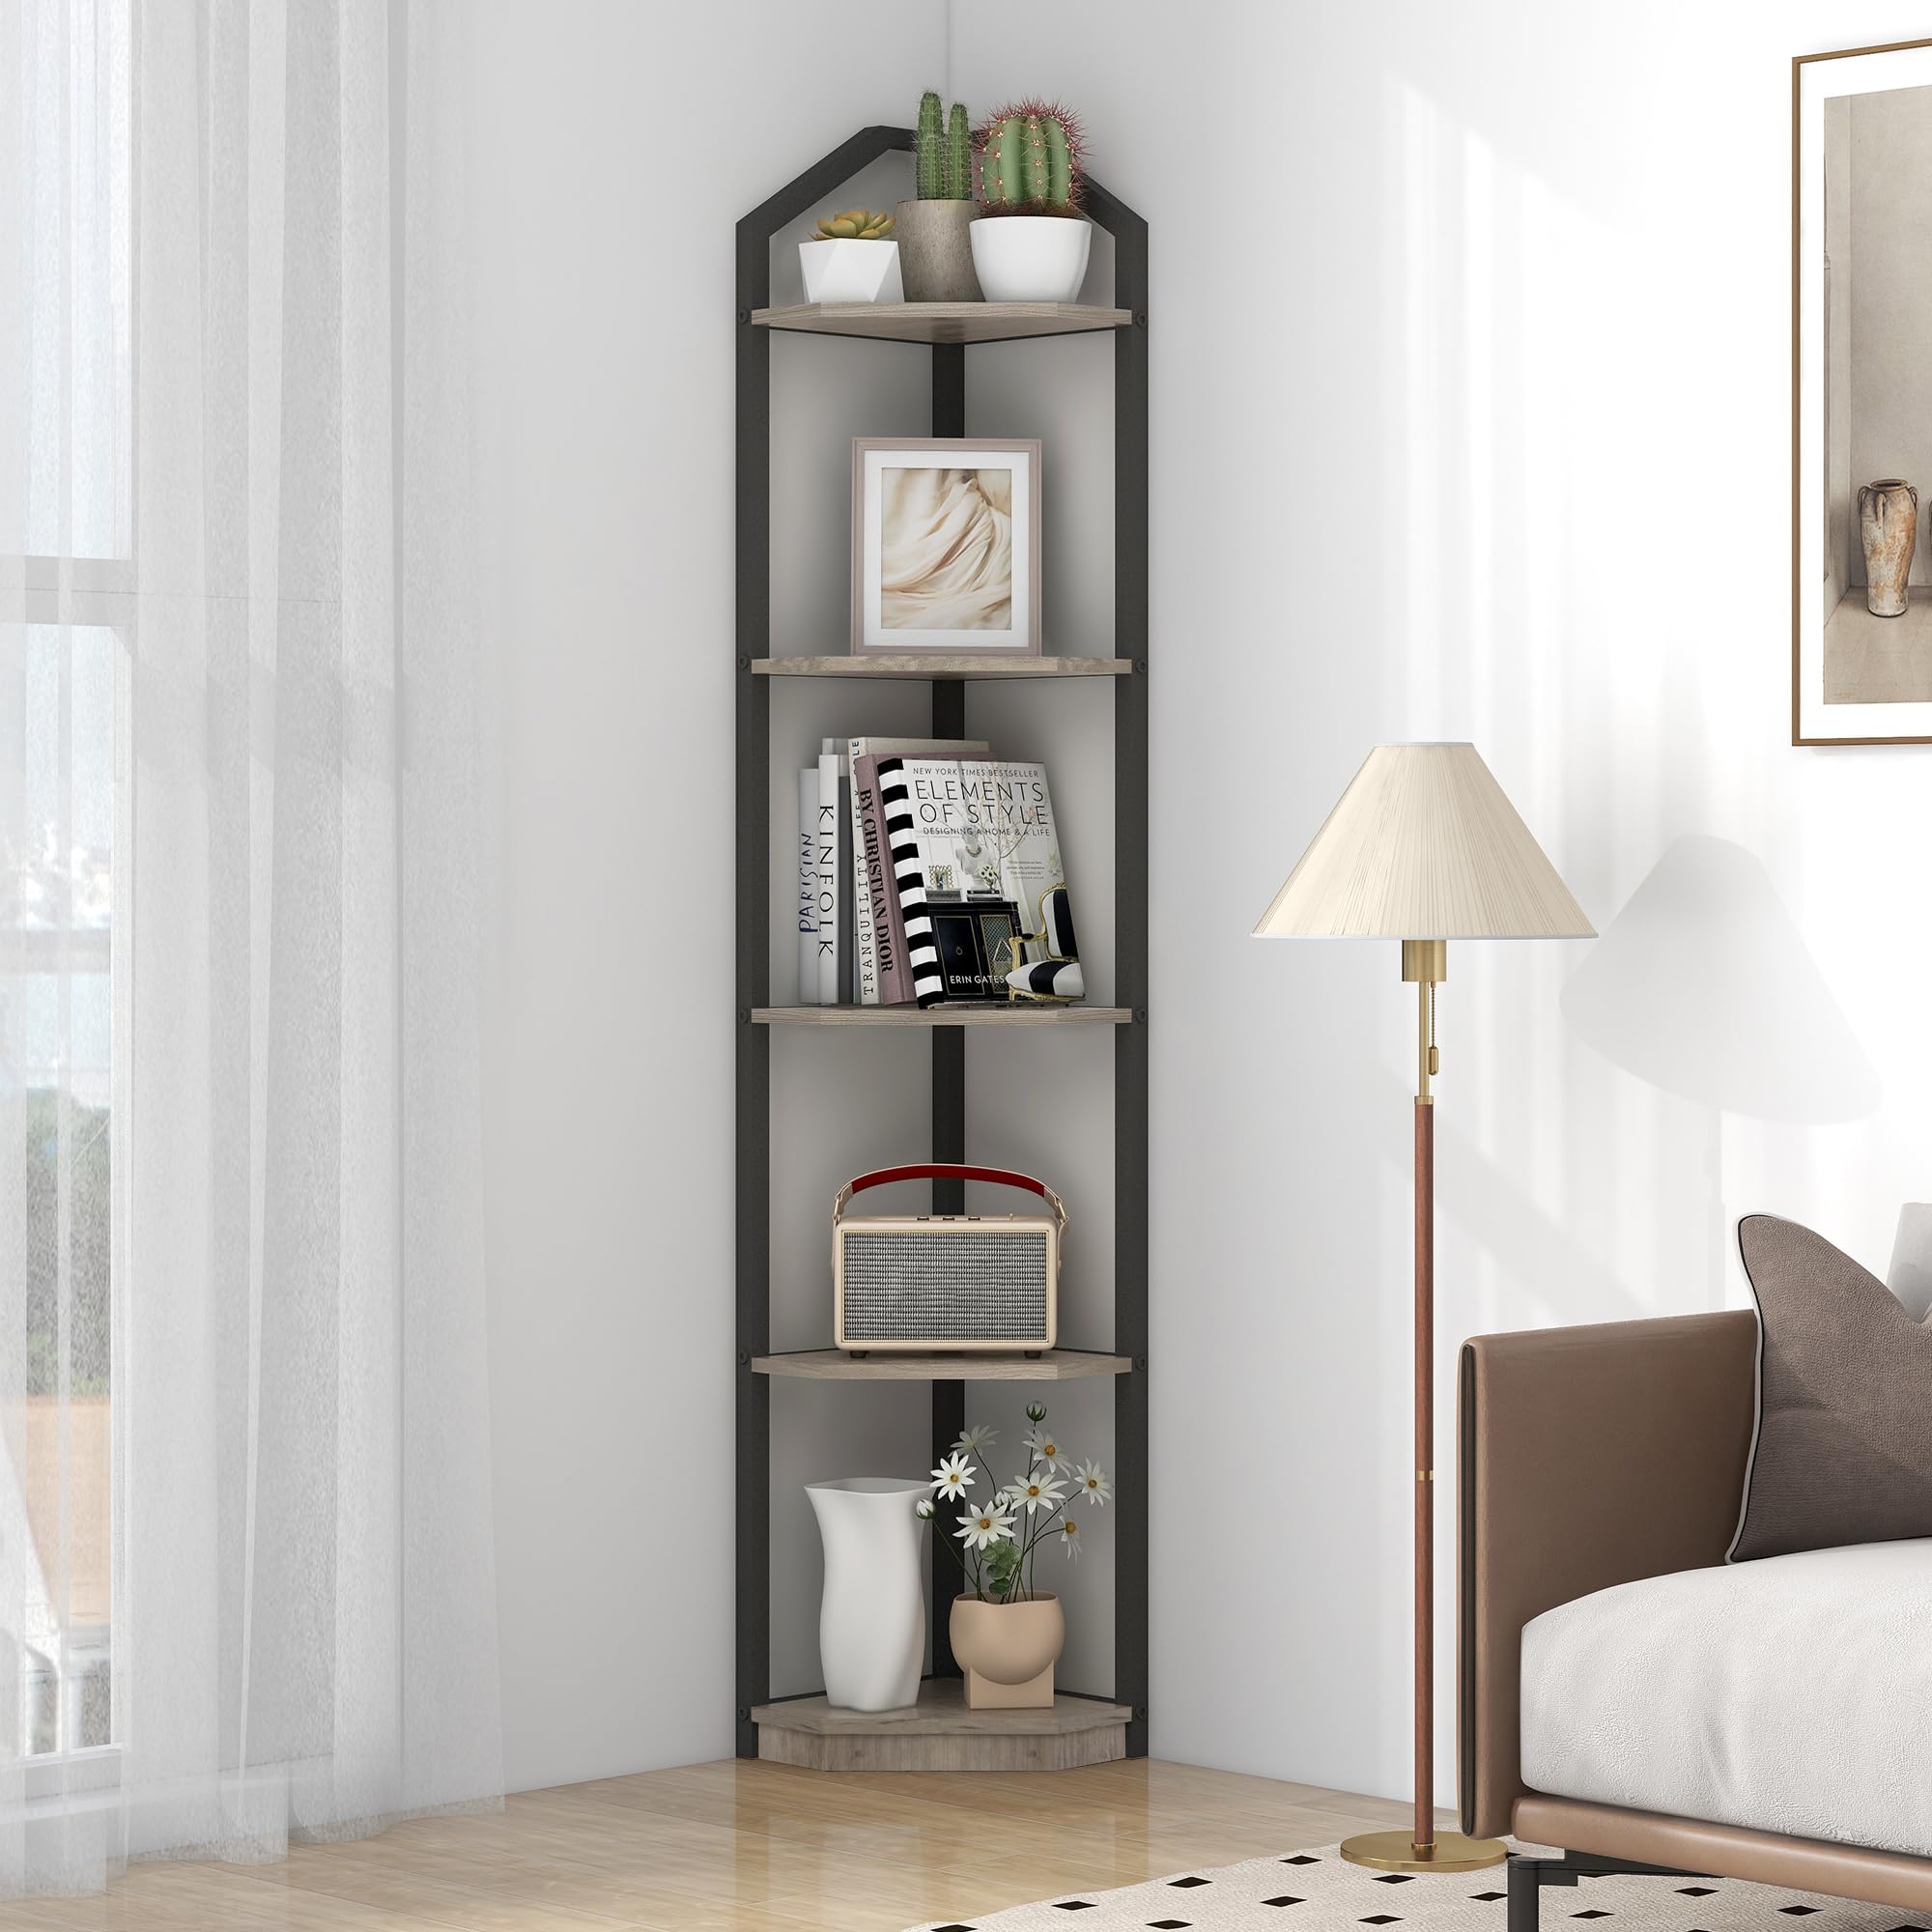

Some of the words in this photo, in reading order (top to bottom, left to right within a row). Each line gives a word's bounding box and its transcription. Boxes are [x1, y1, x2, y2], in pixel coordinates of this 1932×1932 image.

[960, 768, 985, 777] TIMES
[988, 769, 1039, 778] BESTSELLER
[860, 788, 874, 813] BY
[915, 780, 1044, 802] ELEMENTS
[920, 803, 953, 823] OF
[967, 804, 1048, 825] STYLE
[923, 827, 974, 836] DESIGNING
[985, 828, 1011, 837] HOME
[1014, 828, 1021, 837] &
[1032, 829, 1050, 838] LIFE
[819, 805, 834, 958] KINFOLK
[865, 818, 888, 920] CHRISTIAN
[799, 833, 818, 933] PARISIAN
[856, 855, 874, 996] TRANQUILITY
[876, 923, 894, 975] DIOR
[950, 975, 972, 984] ERIN
[974, 975, 1006, 984] GATES
